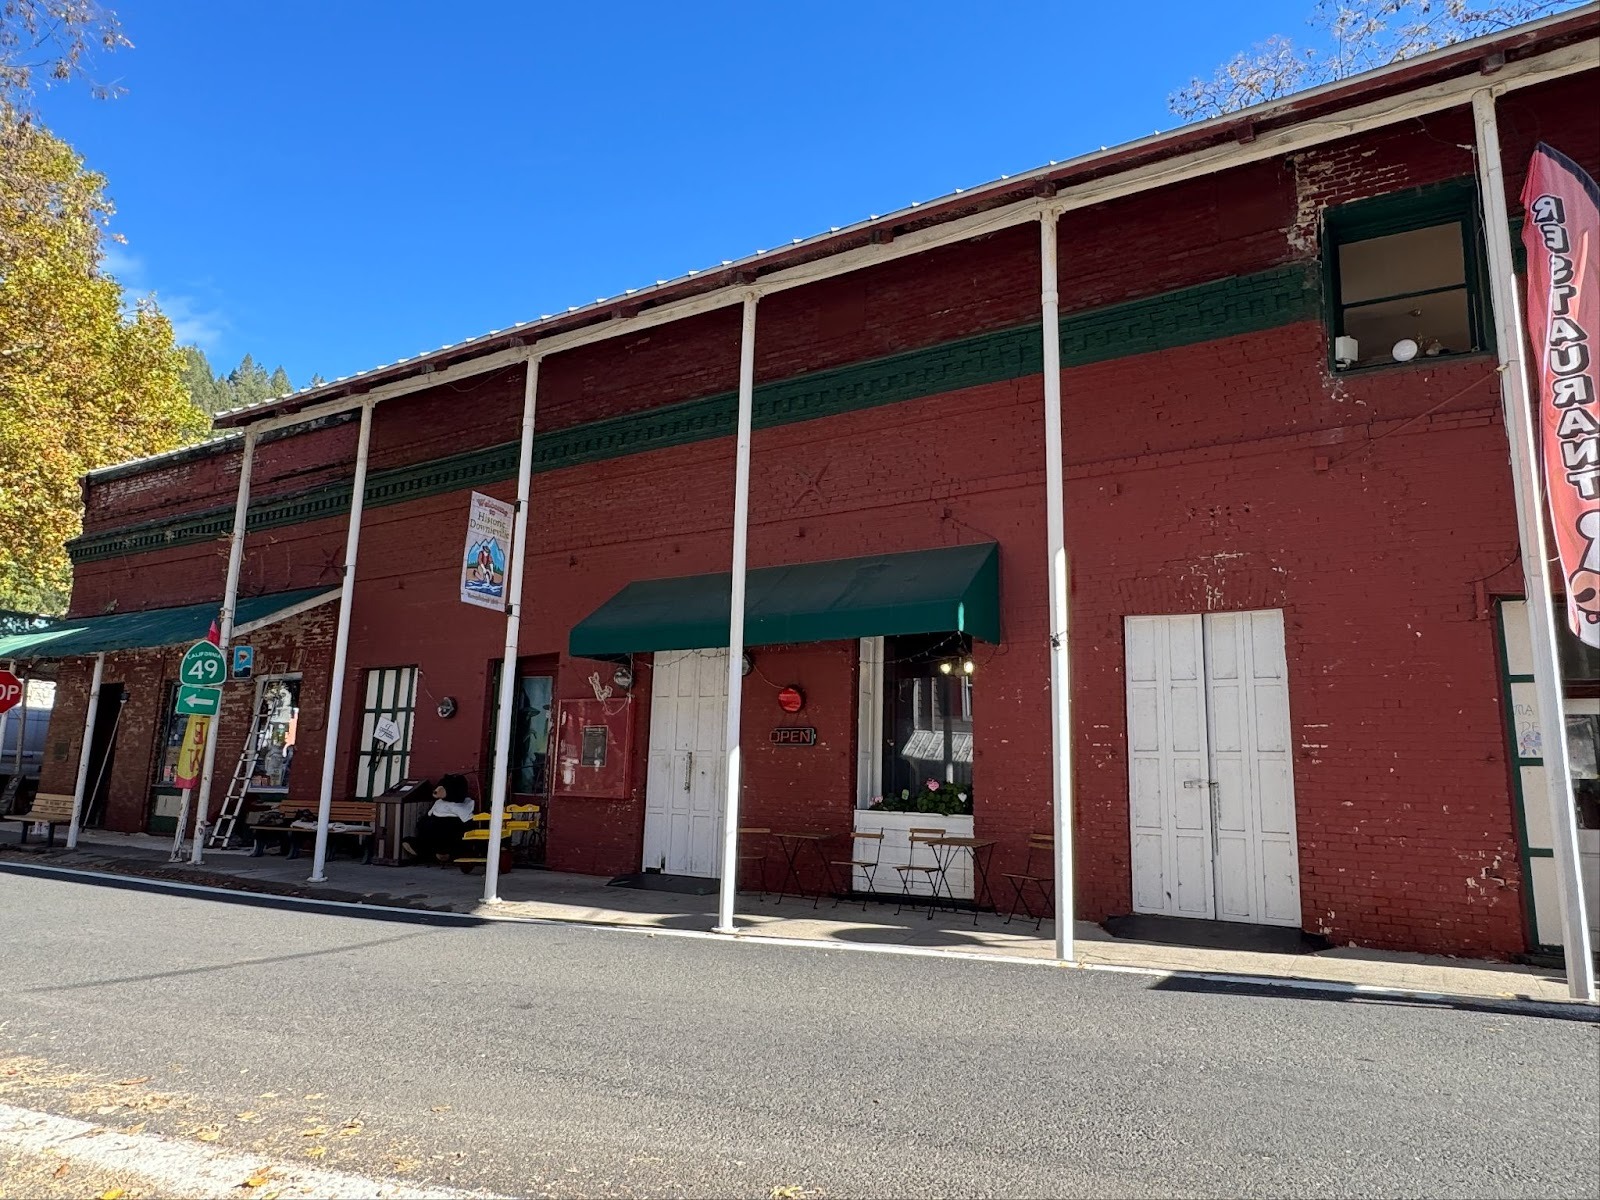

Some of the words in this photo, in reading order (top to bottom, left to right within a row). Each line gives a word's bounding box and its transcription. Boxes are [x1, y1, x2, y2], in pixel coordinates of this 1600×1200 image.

[478, 511, 506, 528] Historic
[187, 651, 221, 660] CALIFORNIA
[187, 659, 218, 679] 49
[0, 683, 20, 701] OP
[769, 730, 811, 743] OPEN
